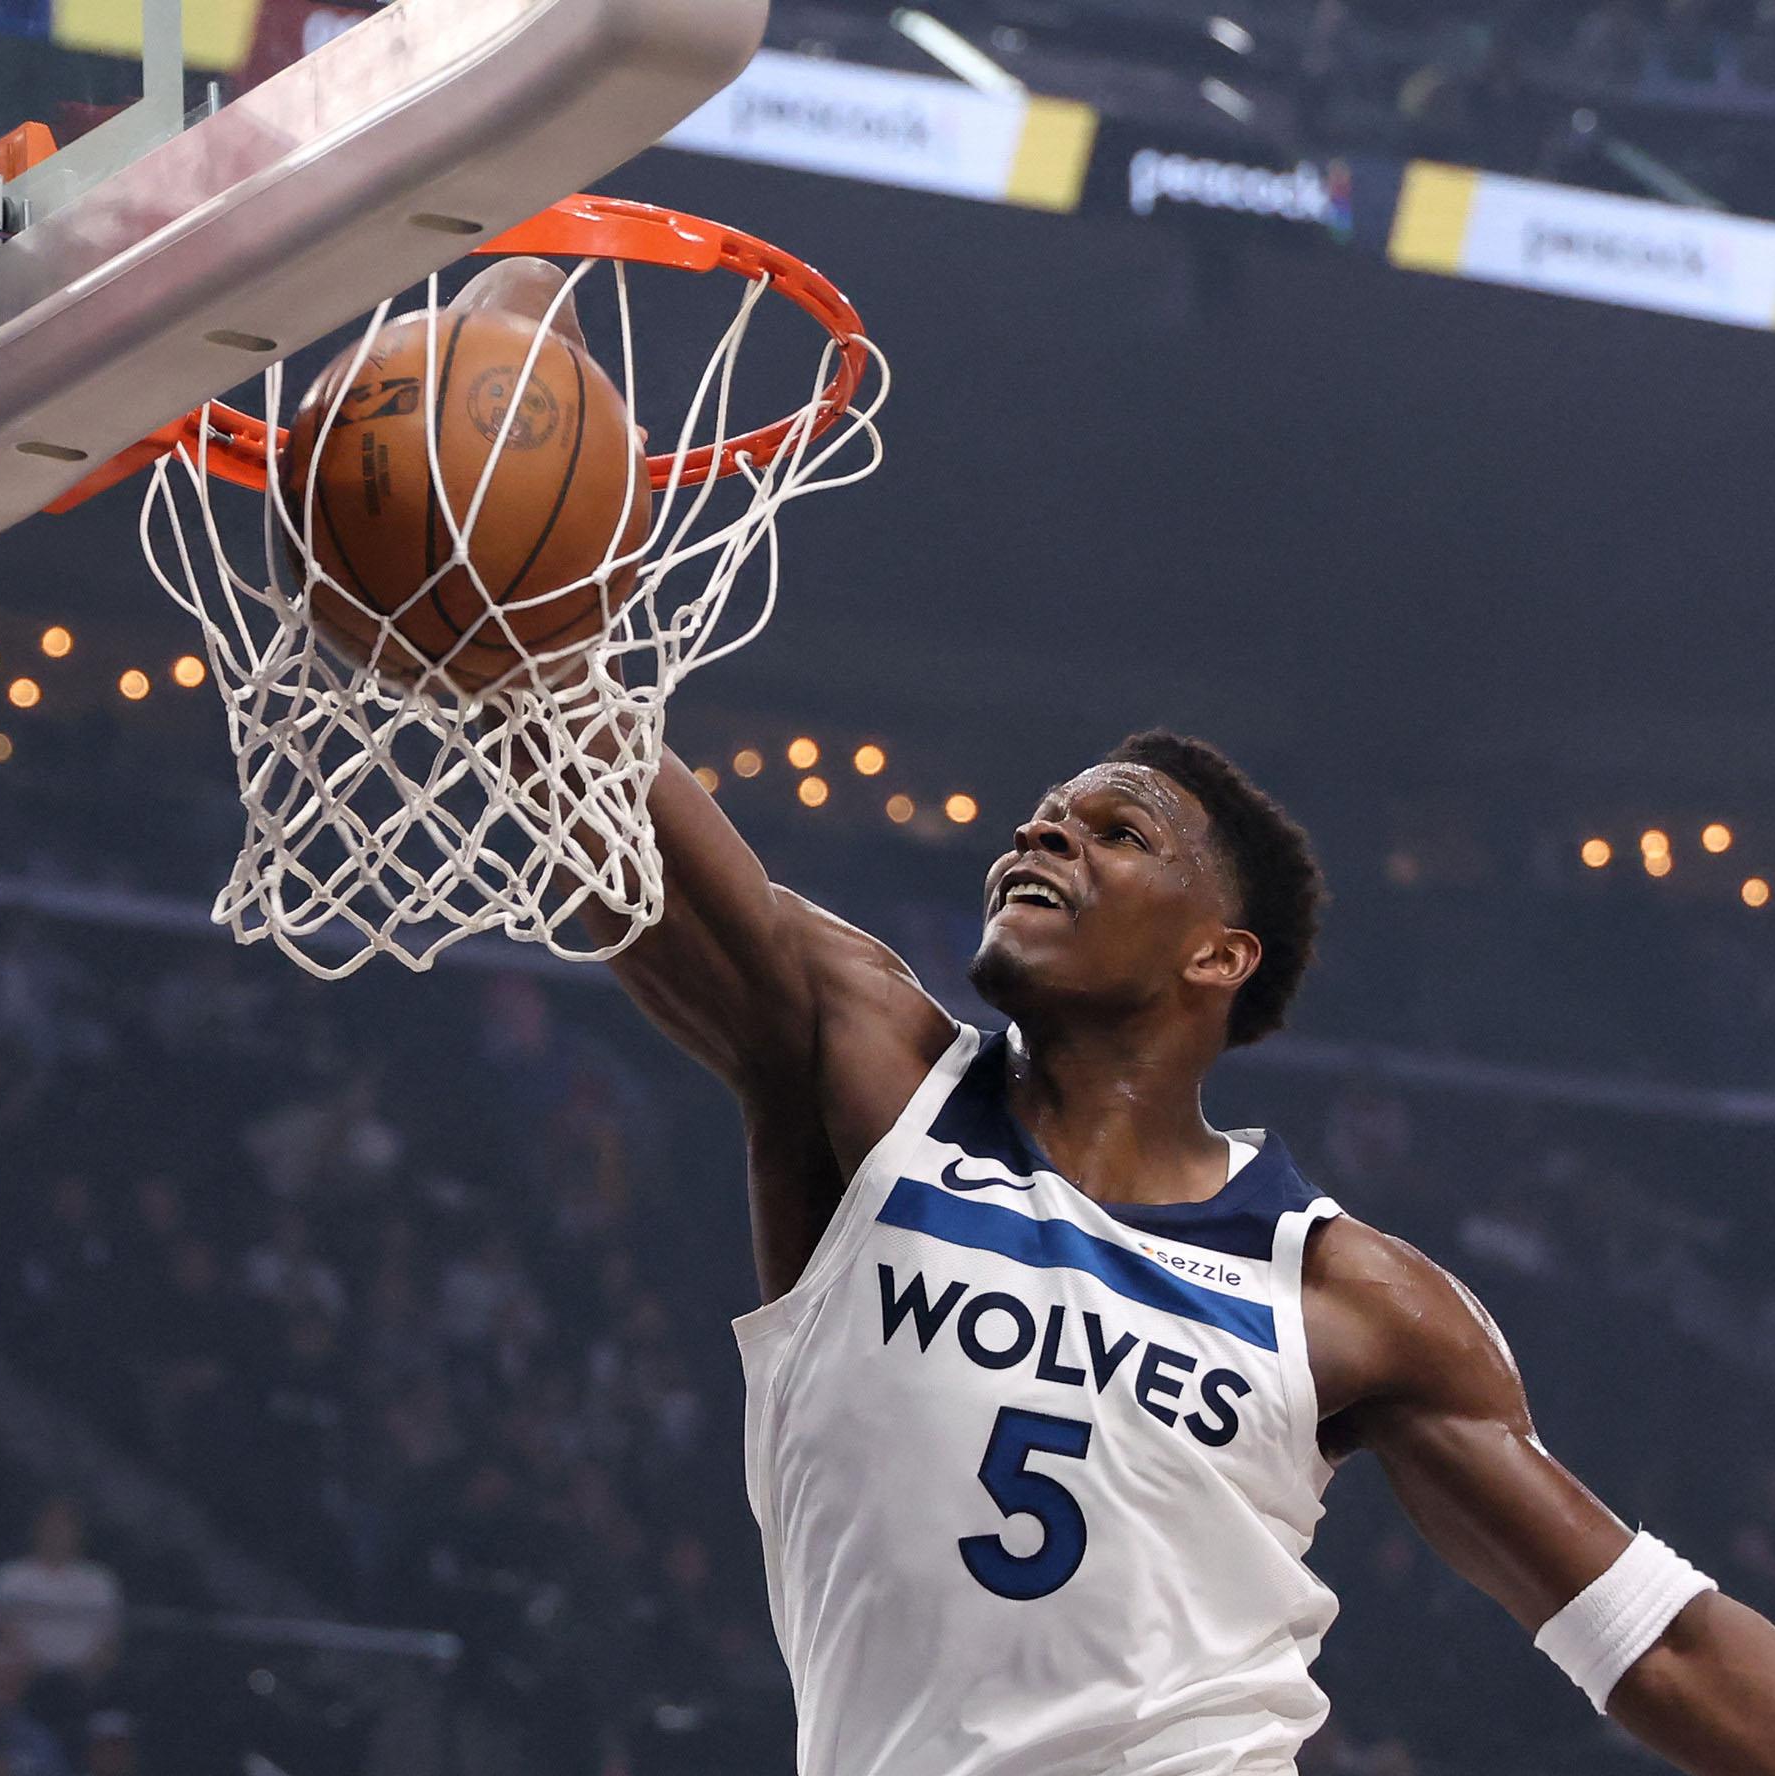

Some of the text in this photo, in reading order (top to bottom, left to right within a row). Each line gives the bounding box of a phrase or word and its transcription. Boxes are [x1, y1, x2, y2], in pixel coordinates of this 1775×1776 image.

[877, 1262, 1252, 1447] WOLVES
[1156, 1249, 1242, 1288] sezzle
[958, 1405, 1093, 1601] 5
